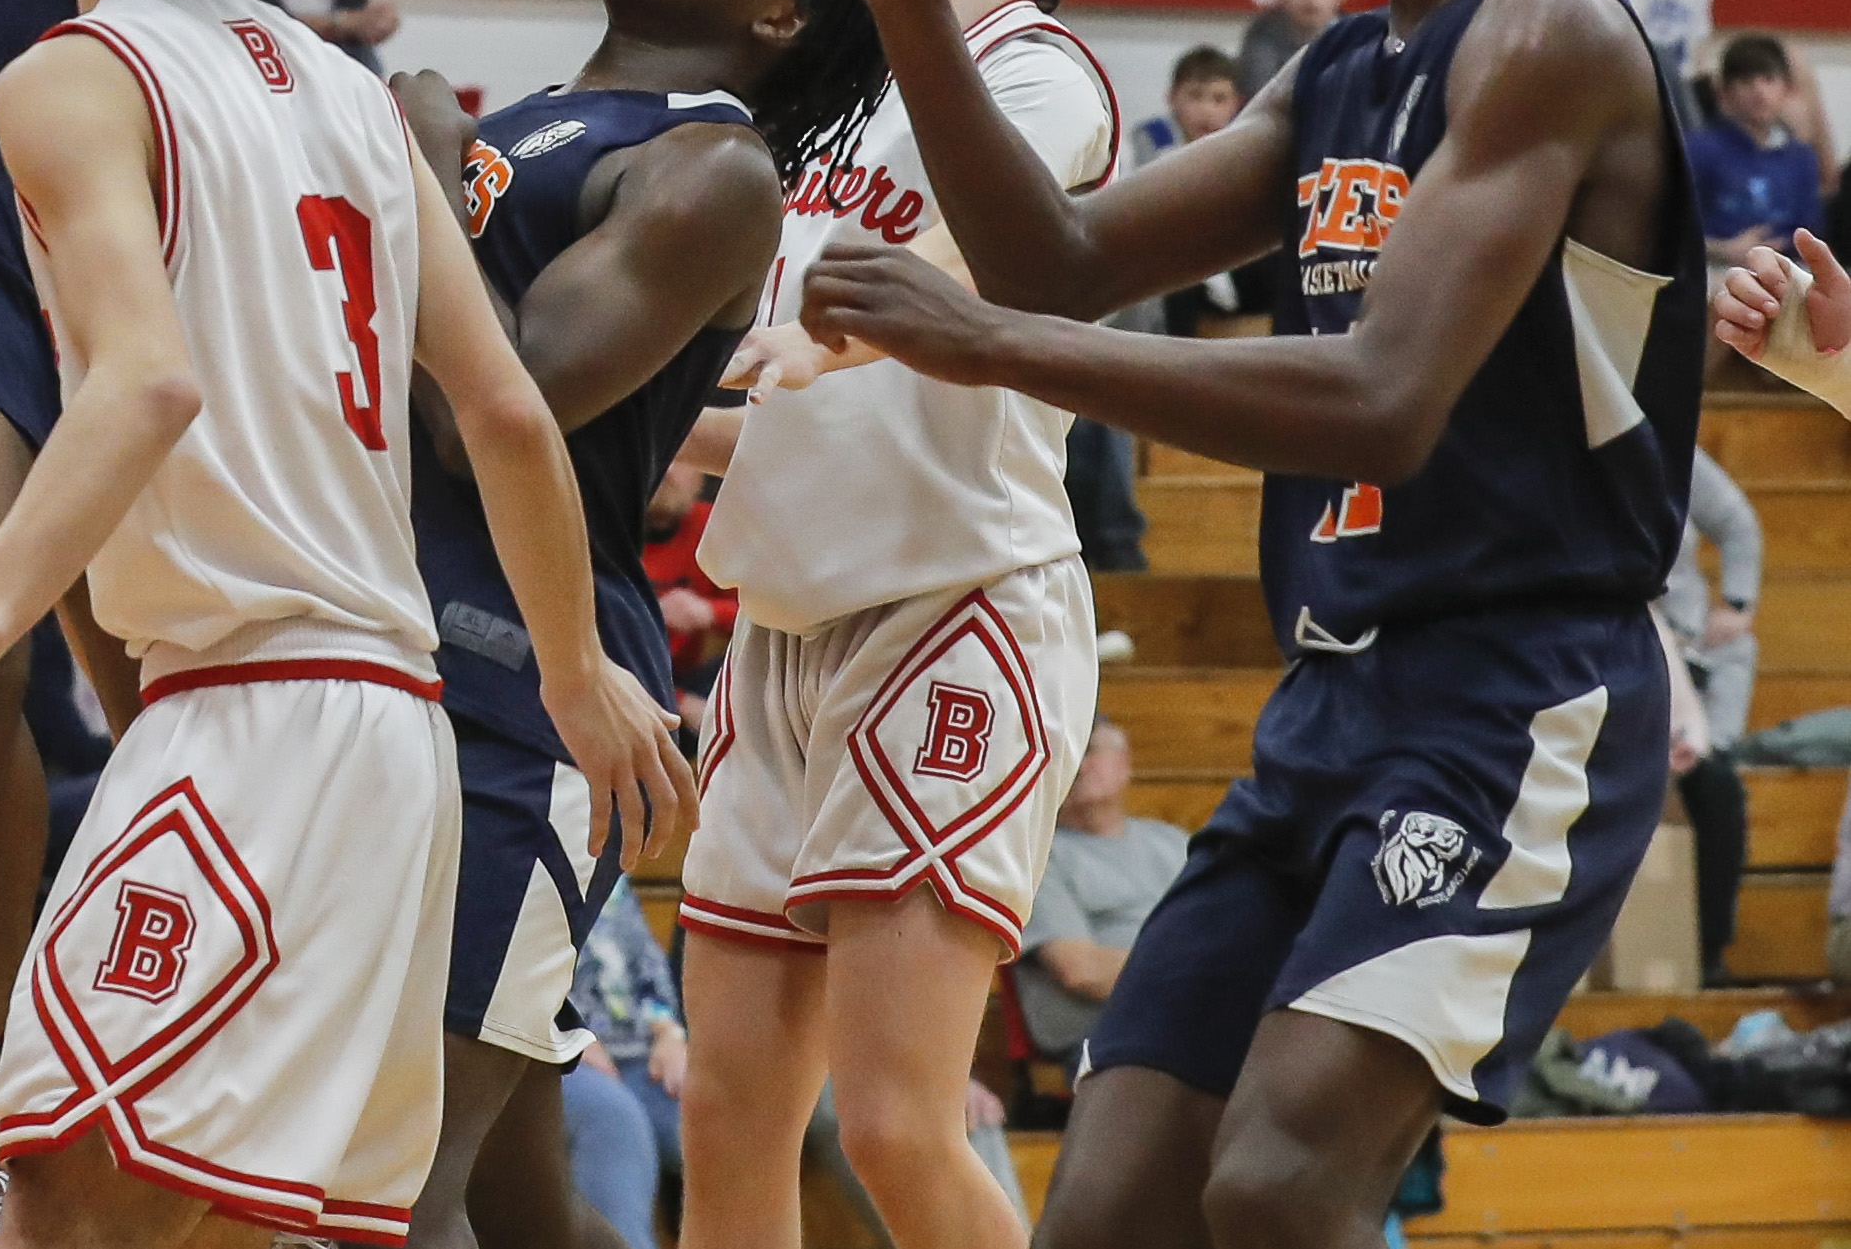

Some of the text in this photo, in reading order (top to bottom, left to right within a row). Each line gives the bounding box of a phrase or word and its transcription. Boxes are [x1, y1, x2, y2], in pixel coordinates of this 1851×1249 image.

[223, 18, 295, 93] B
[296, 193, 388, 451] 3
[912, 680, 996, 784] B
[92, 879, 197, 1005] B
